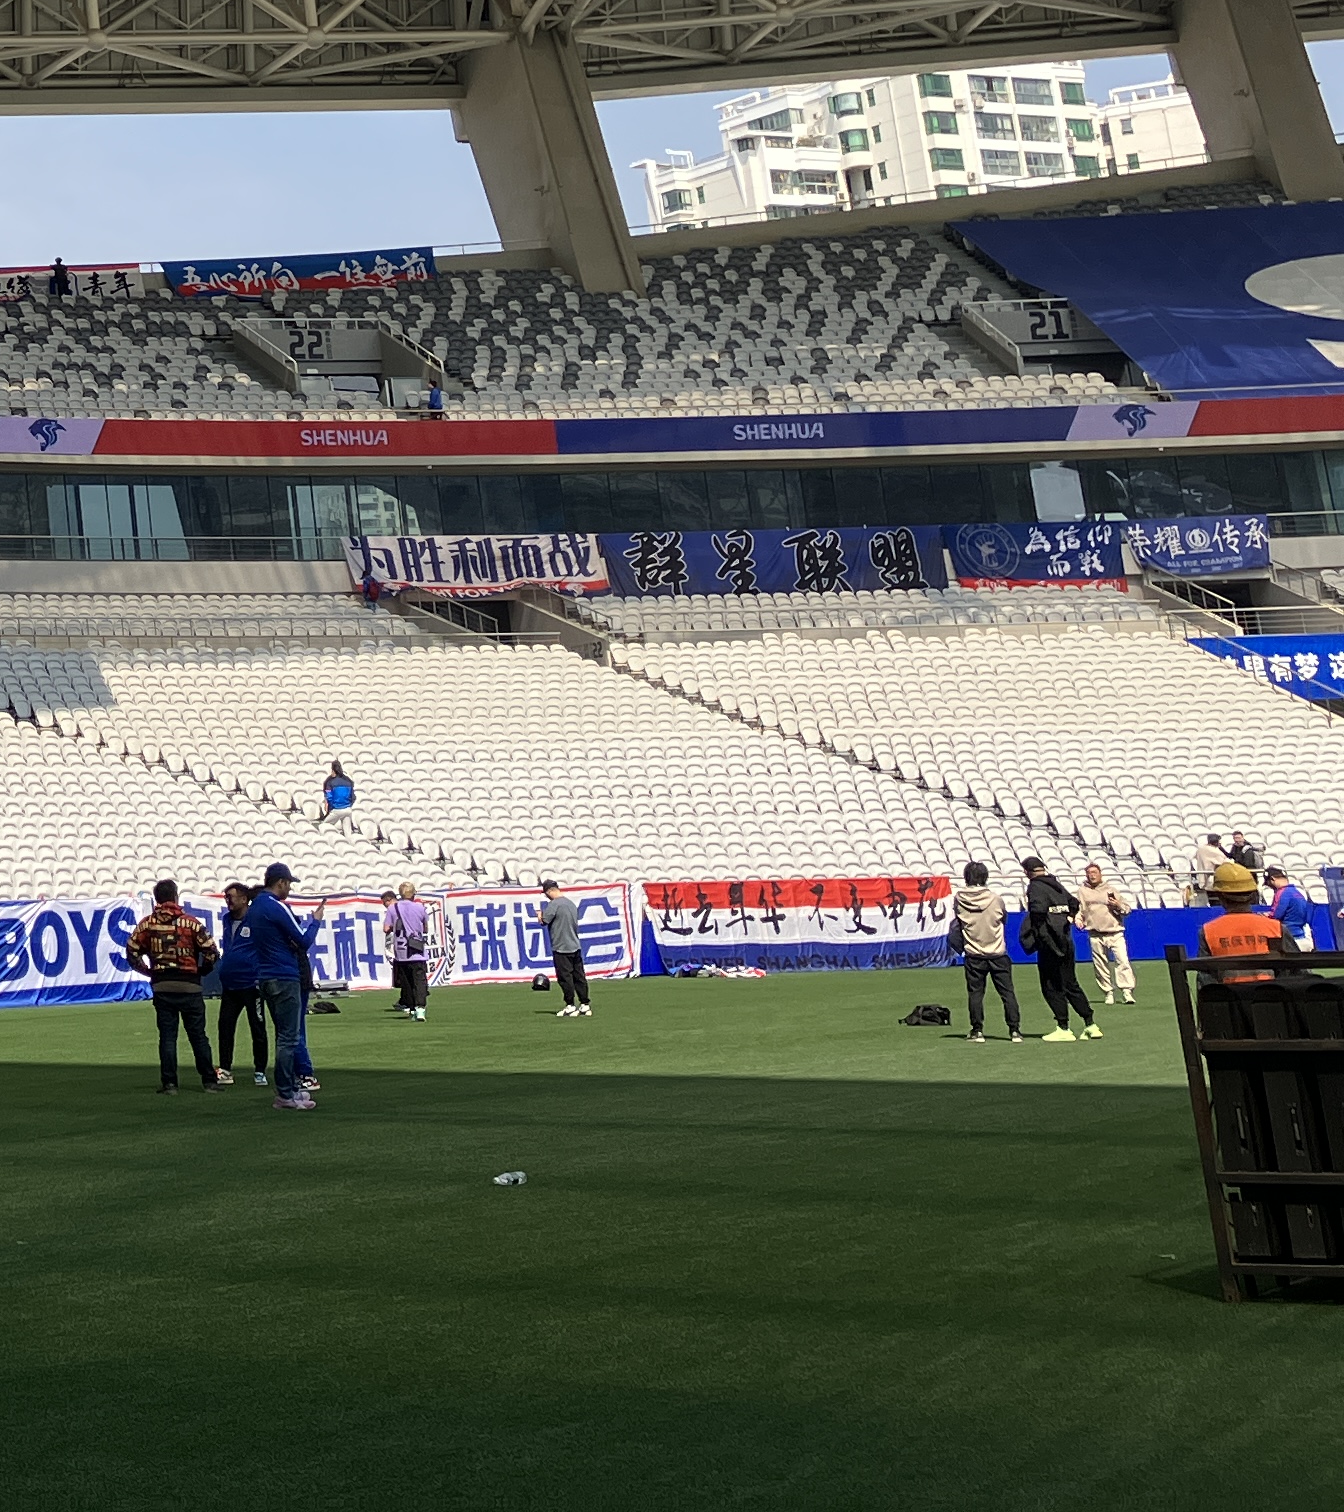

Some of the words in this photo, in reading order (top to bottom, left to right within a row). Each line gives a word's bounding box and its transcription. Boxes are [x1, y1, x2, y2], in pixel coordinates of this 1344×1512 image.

[83, 271, 135, 299] 青年
[183, 261, 300, 292] 吾心所向
[1028, 310, 1069, 340] 21
[289, 330, 324, 359] 22
[300, 429, 390, 448] SHENHUA
[732, 422, 825, 443] SHENHUA
[1127, 523, 1186, 559] 荣耀
[1212, 517, 1269, 554] 传承
[350, 533, 598, 585] 为胜利而战
[756, 953, 859, 971] SHANGHAI
[871, 950, 944, 968] SHENH
